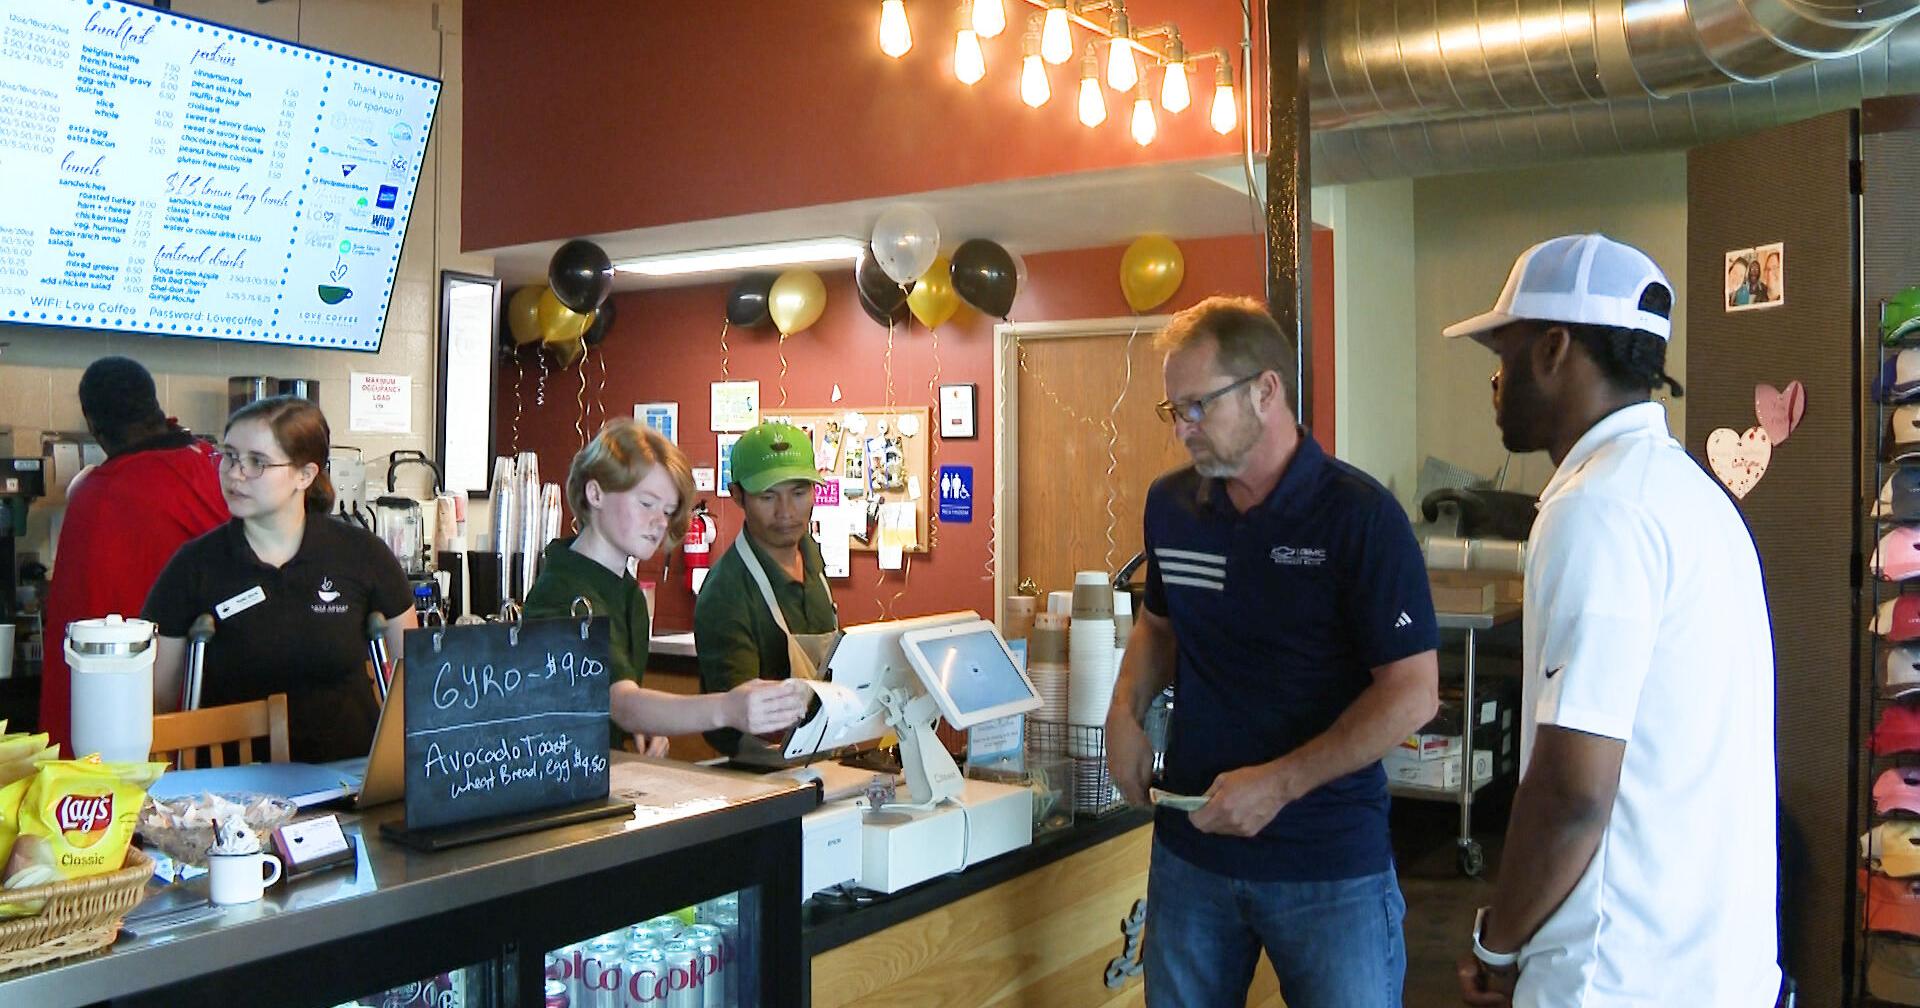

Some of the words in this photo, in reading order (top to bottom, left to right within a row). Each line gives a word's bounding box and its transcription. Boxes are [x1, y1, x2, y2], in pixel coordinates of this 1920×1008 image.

[353, 82, 376, 96] Thank
[378, 90, 394, 100] you
[348, 98, 362, 106] our
[66, 300, 94, 310] Love
[98, 302, 136, 314] Coffee
[326, 314, 358, 322] COFFEE
[815, 484, 838, 494] OVE
[433, 662, 521, 710] GYRO
[546, 652, 604, 687] $9.00
[426, 738, 520, 778] Avocado
[520, 733, 572, 757] Toast
[574, 746, 606, 777] $9.50
[62, 795, 110, 834] Lay's
[62, 852, 104, 865] Classic
